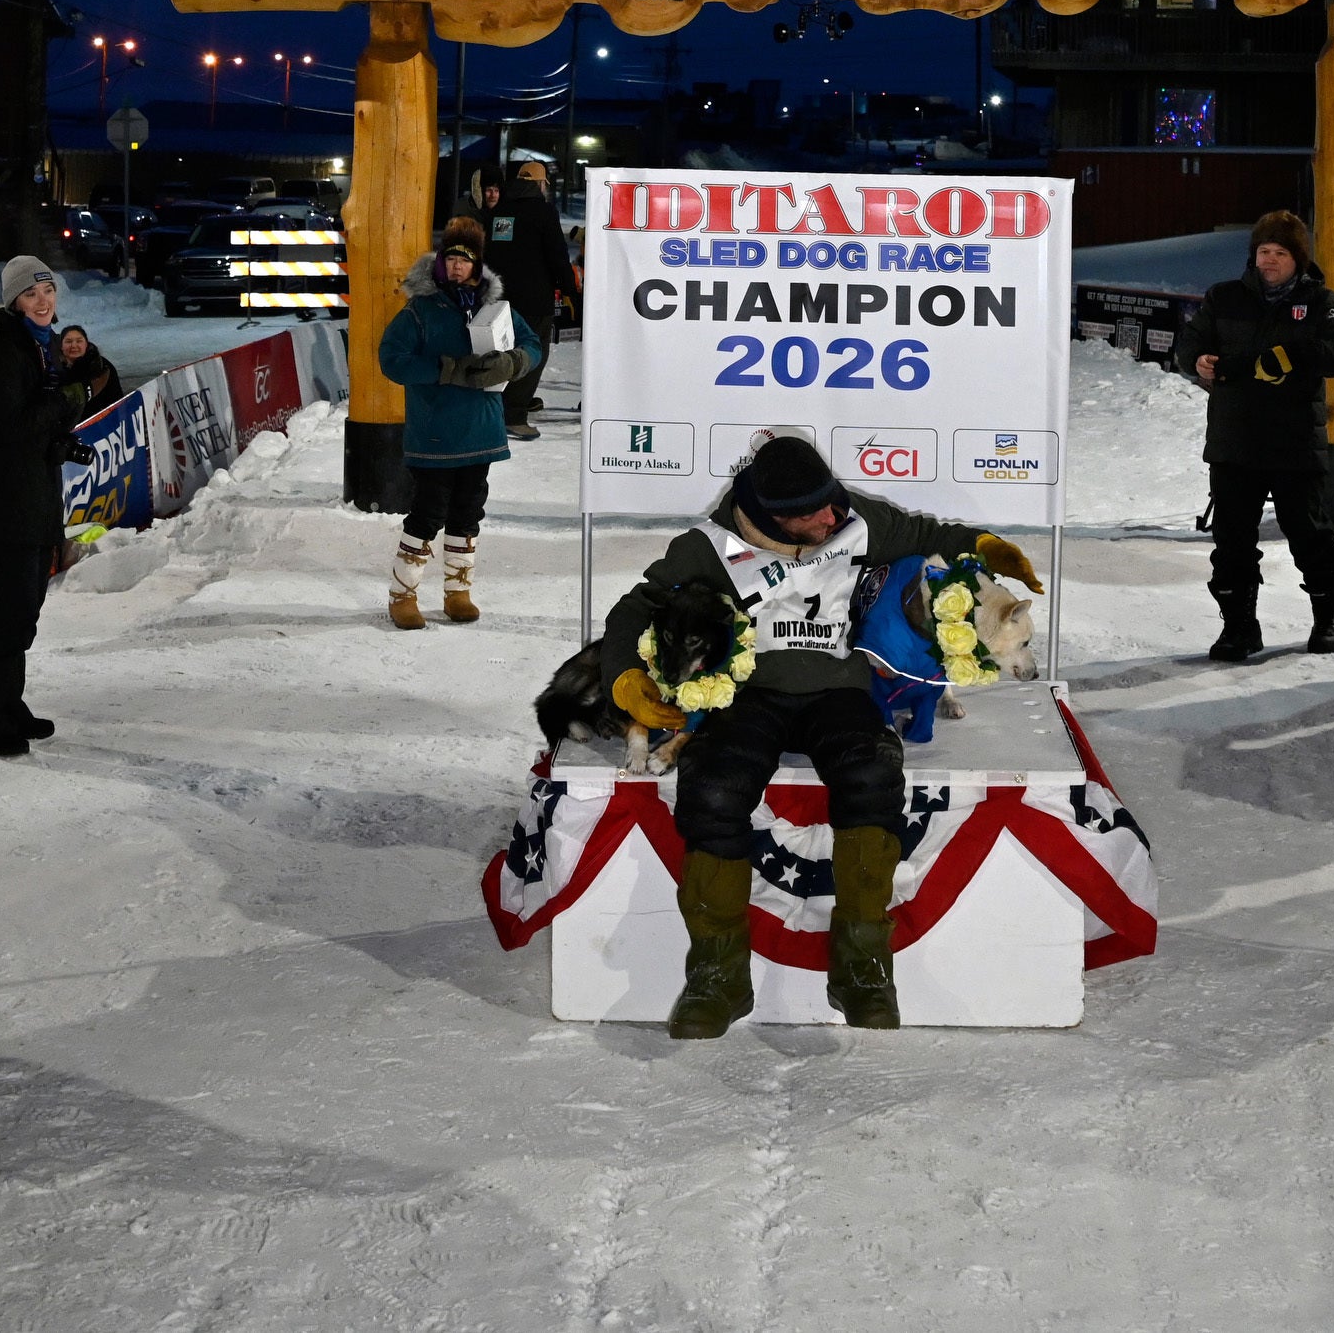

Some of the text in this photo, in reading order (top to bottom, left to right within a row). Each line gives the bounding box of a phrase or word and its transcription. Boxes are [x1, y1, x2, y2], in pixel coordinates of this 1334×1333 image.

[603, 180, 1051, 240] IDITAROD
[660, 238, 991, 273] SLED DOG RACE
[633, 278, 1016, 328] CHAMPION
[714, 335, 931, 391] 2026
[601, 456, 681, 470] Hilcorp Alaska
[859, 448, 919, 478] GCI
[974, 458, 1039, 471] DONLIN
[983, 469, 1028, 480] GOLD
[786, 547, 849, 570] Hilcorp Alaska
